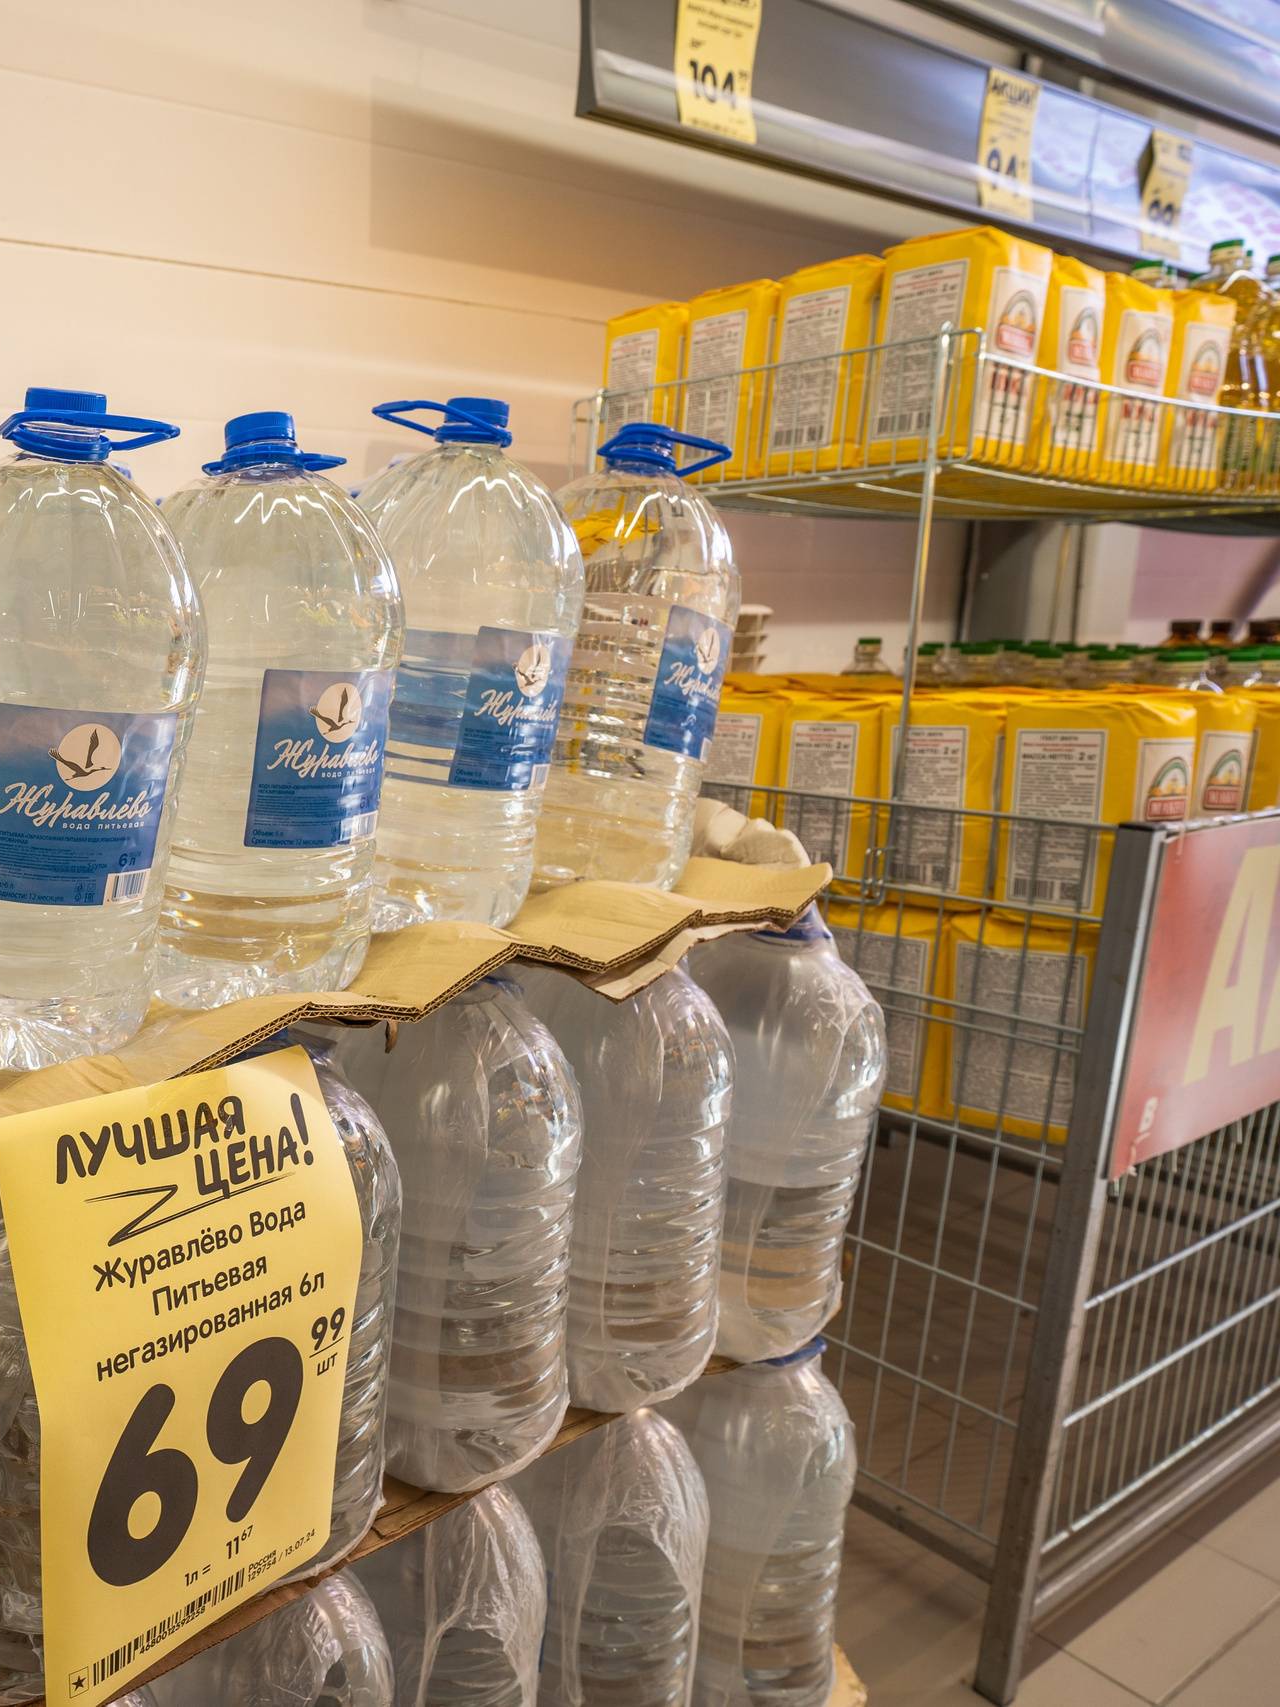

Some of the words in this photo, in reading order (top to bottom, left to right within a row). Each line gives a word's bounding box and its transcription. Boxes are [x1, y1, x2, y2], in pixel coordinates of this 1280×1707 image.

[62, 822, 90, 831] вода
[97, 821, 145, 830] питьевая
[118, 853, 128, 867] 6
[1182, 845, 1280, 1084] А
[55, 1095, 246, 1184] ЛУЧШАЯ
[194, 1092, 315, 1199] ЦЕНА!
[92, 1222, 243, 1292] Журавлёво
[249, 1201, 307, 1236] Вода
[152, 1256, 267, 1315] Питьевая
[96, 1285, 292, 1381] негазированная
[299, 1271, 325, 1297] 6л
[310, 1307, 346, 1350] 99
[317, 1352, 338, 1376] шт
[87, 1336, 304, 1587] 69
[184, 1571, 198, 1587] 1л
[248, 1556, 277, 1582] 129754
[285, 1529, 316, 1557] 13.07.24
[248, 1549, 277, 1573] Россия
